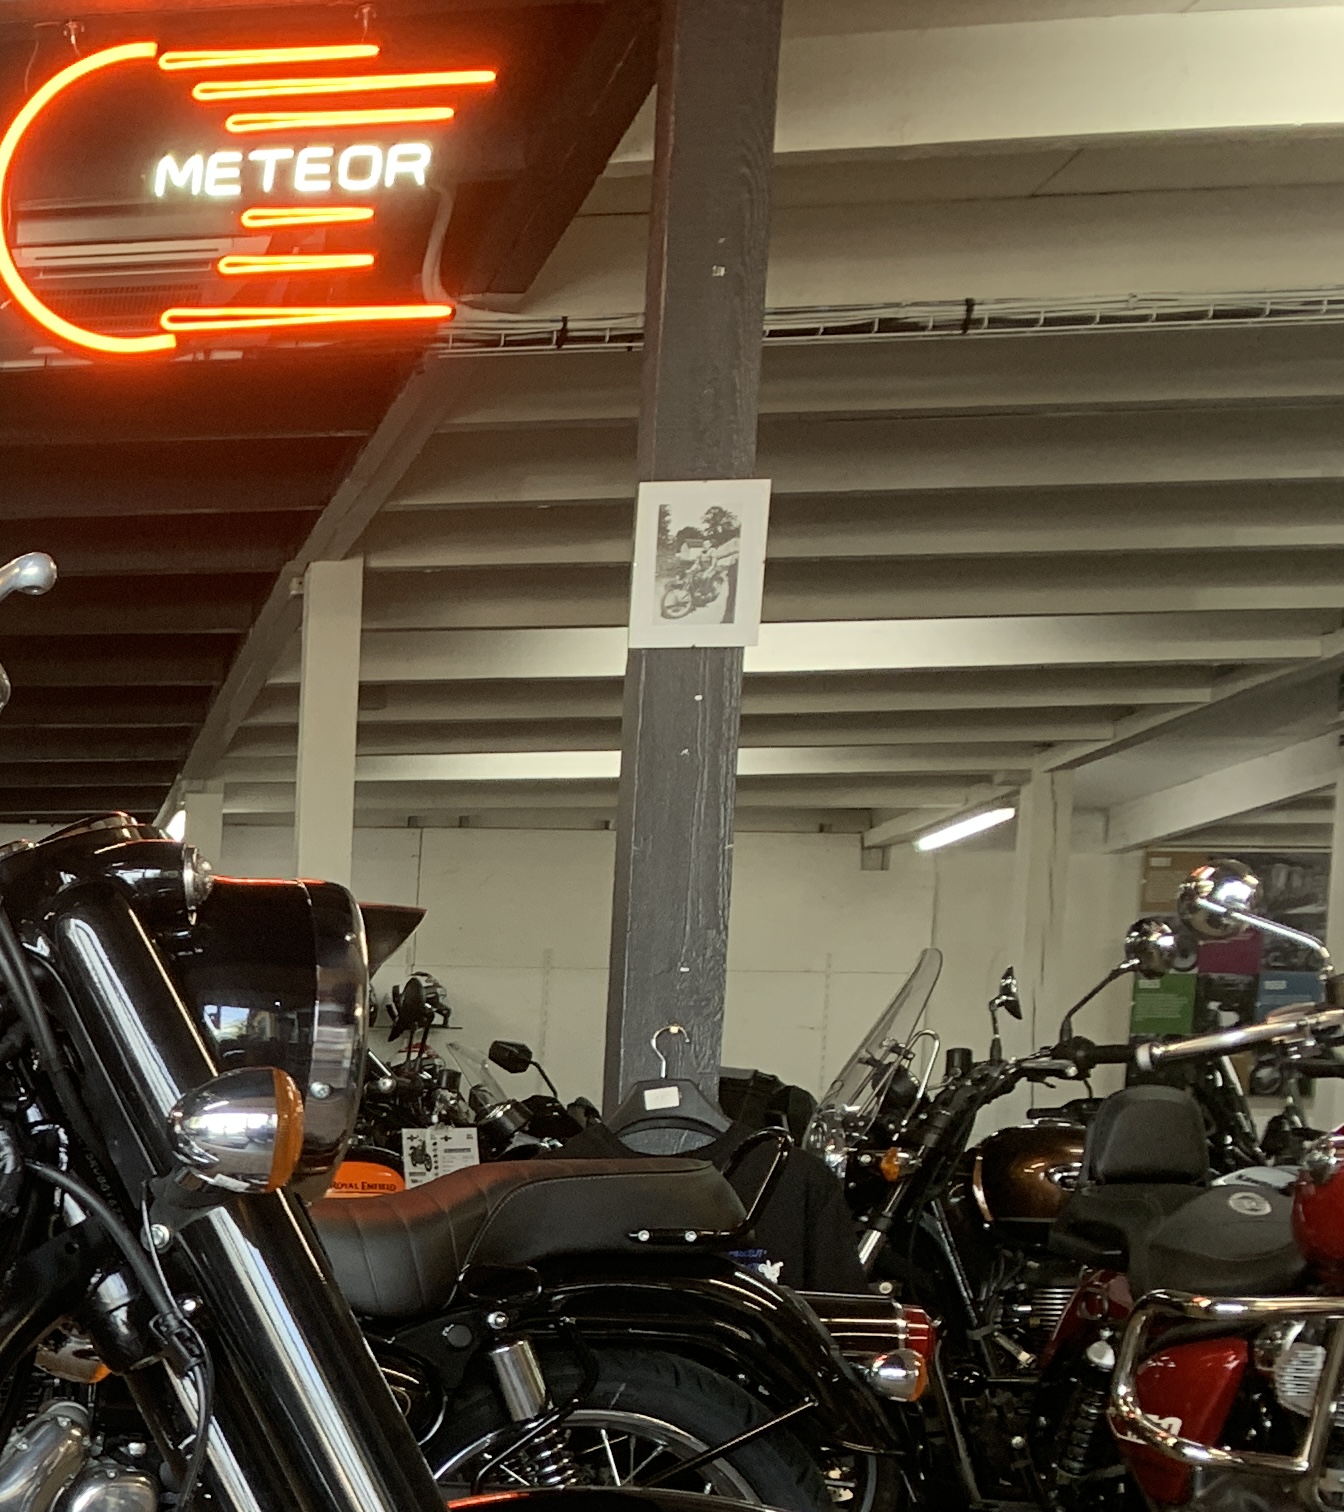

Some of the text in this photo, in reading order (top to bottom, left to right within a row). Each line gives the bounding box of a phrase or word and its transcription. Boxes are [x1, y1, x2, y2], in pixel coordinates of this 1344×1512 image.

[153, 141, 433, 198] METEOR
[331, 1181, 359, 1191] ROYAL
[361, 1181, 398, 1192] ENFIELD
